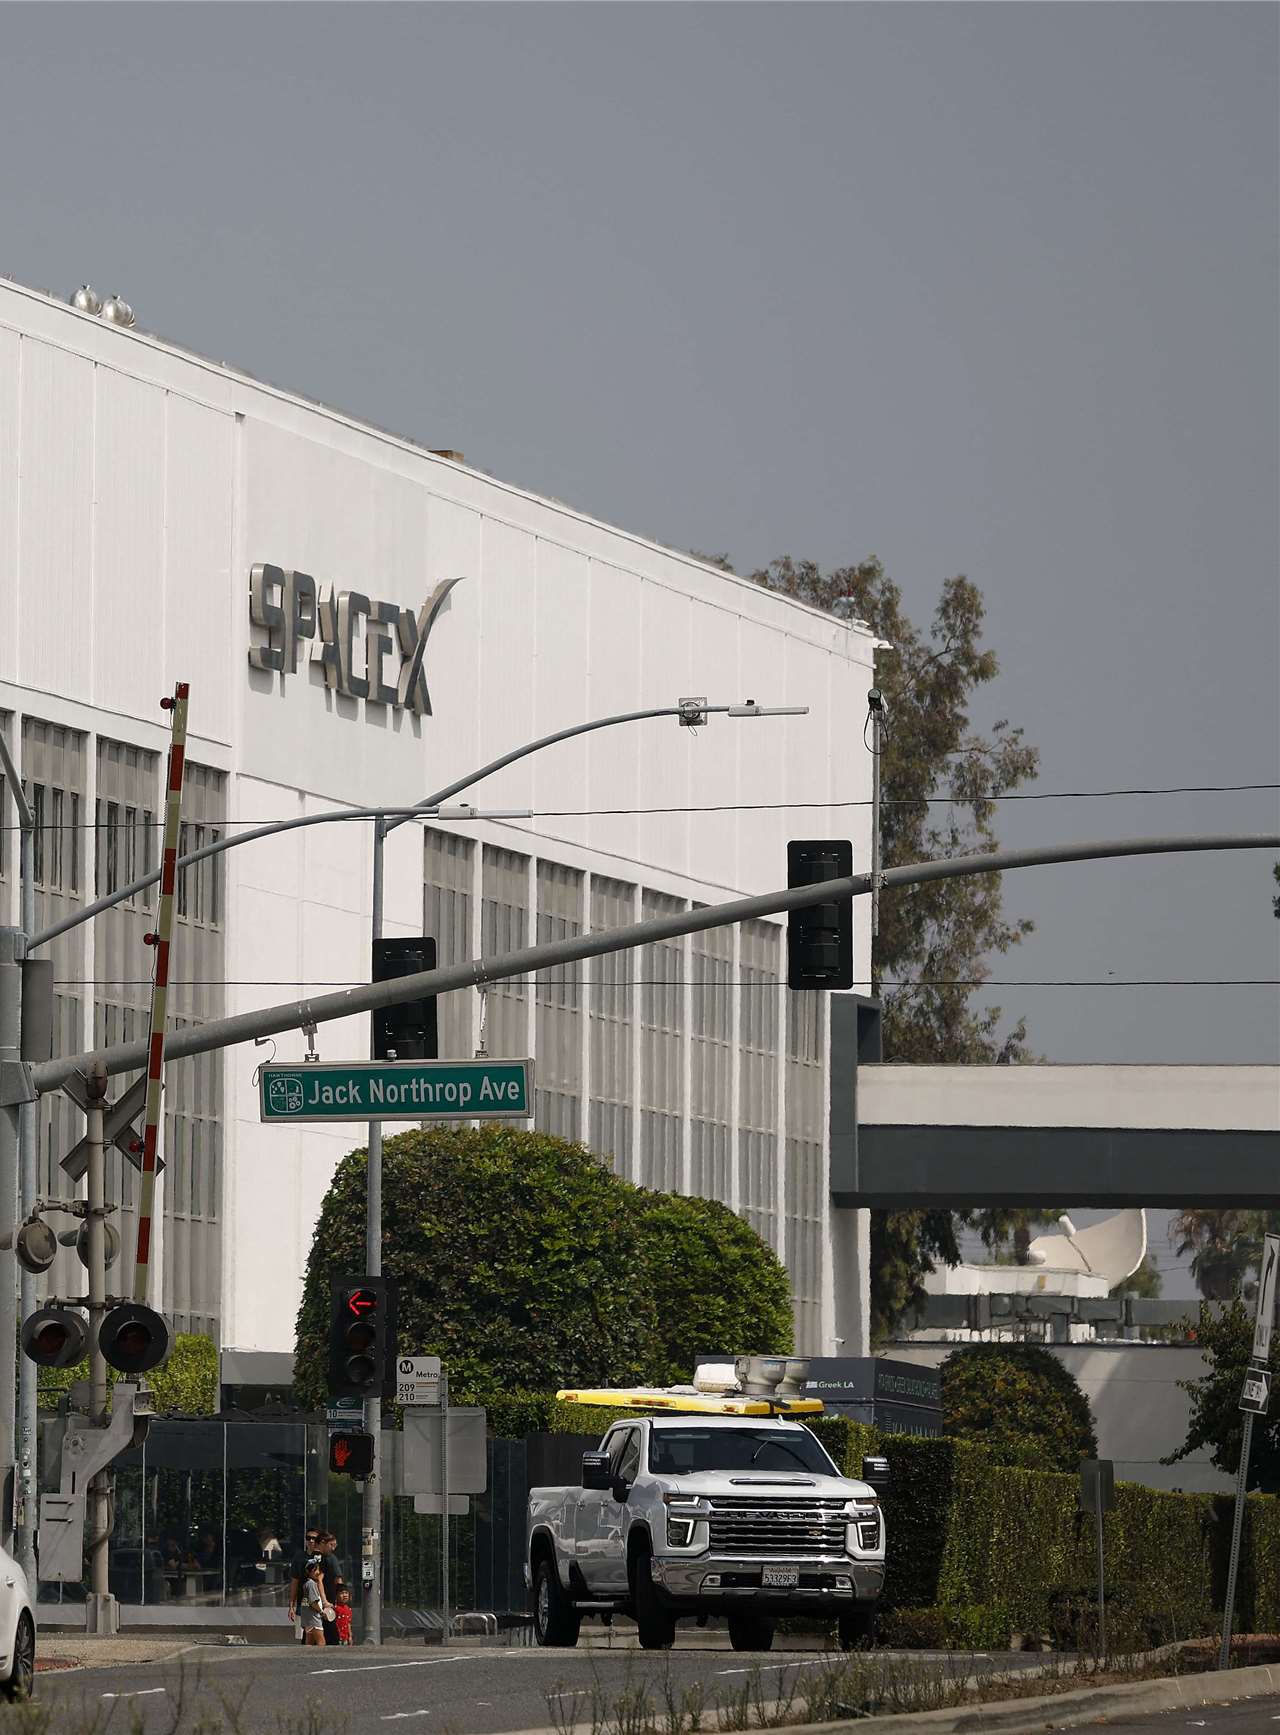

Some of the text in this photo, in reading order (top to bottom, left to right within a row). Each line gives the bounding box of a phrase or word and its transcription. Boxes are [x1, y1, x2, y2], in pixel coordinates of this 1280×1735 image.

[248, 563, 466, 716] SPACEX
[308, 1076, 520, 1106] Jack Northrop Ave
[400, 1383, 415, 1392] 209
[819, 1381, 855, 1389] Greek LA
